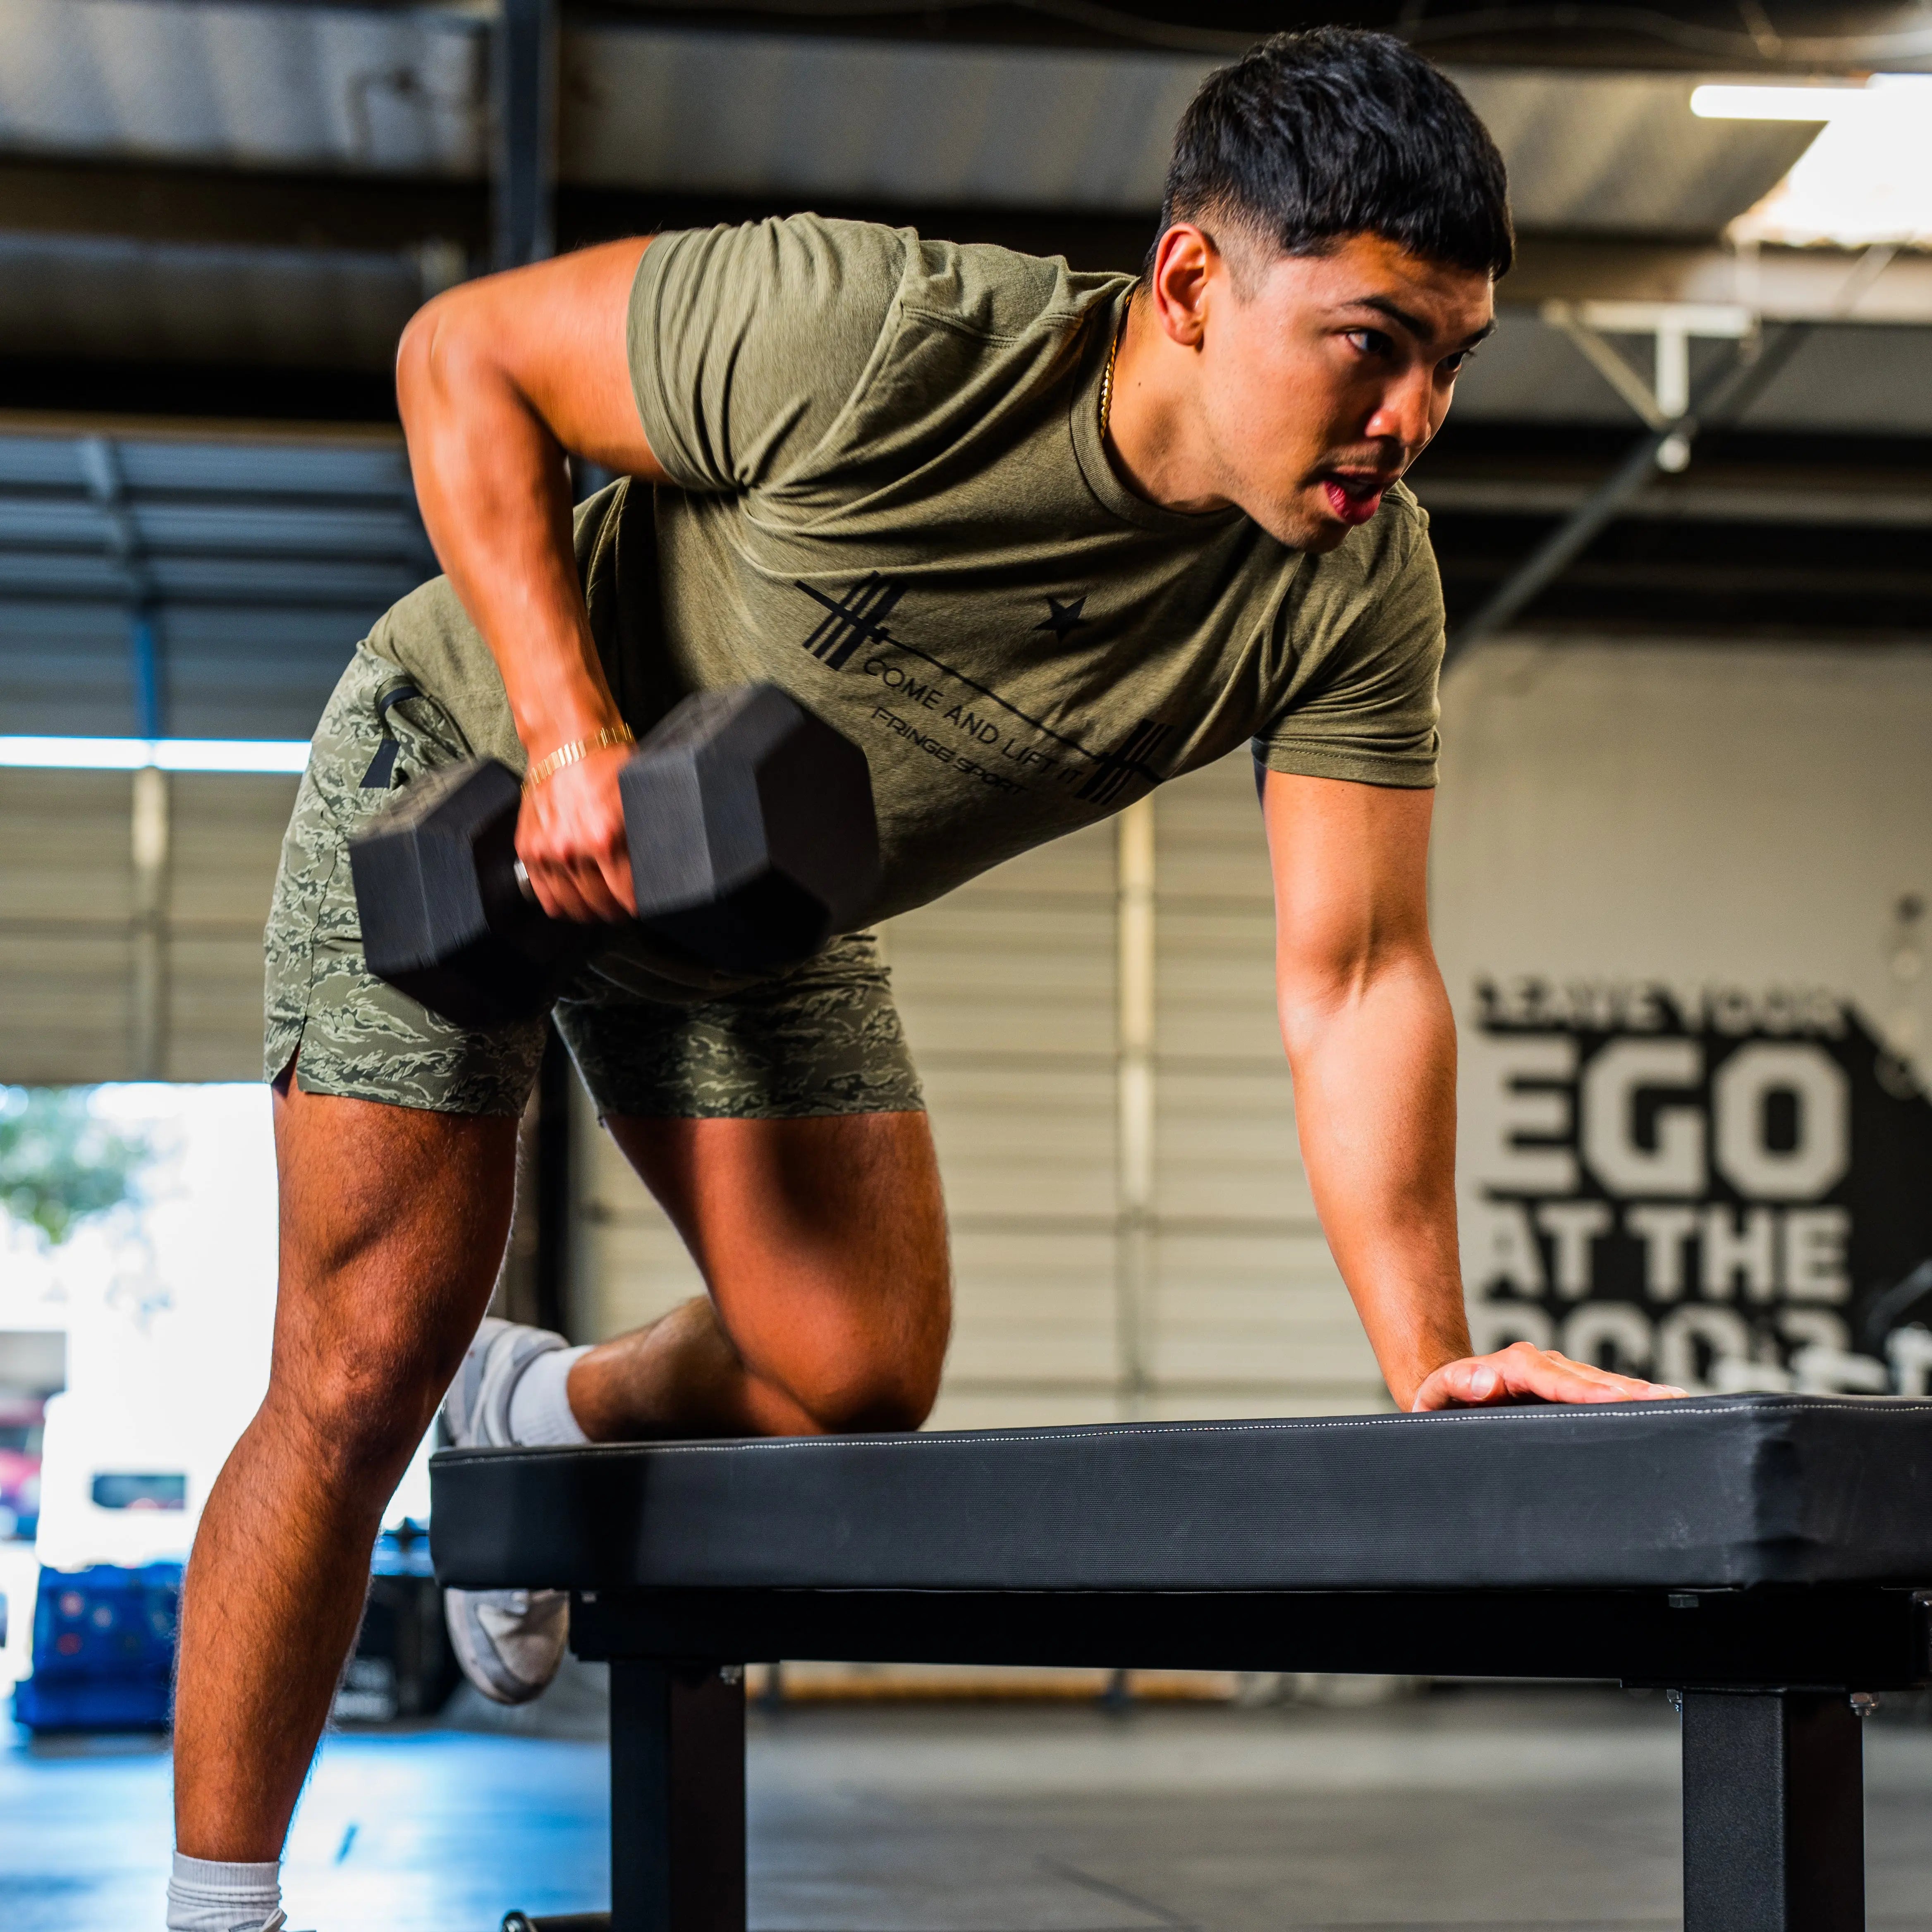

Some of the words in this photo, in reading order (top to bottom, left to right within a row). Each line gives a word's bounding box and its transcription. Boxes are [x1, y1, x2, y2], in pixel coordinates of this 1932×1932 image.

[864, 658, 945, 710] COME
[943, 704, 999, 744] AND
[1002, 739, 1059, 773] LIFT
[1477, 1033, 1851, 1200] EGO
[1478, 1203, 1611, 1302] AT
[1624, 1203, 1853, 1306] THE
